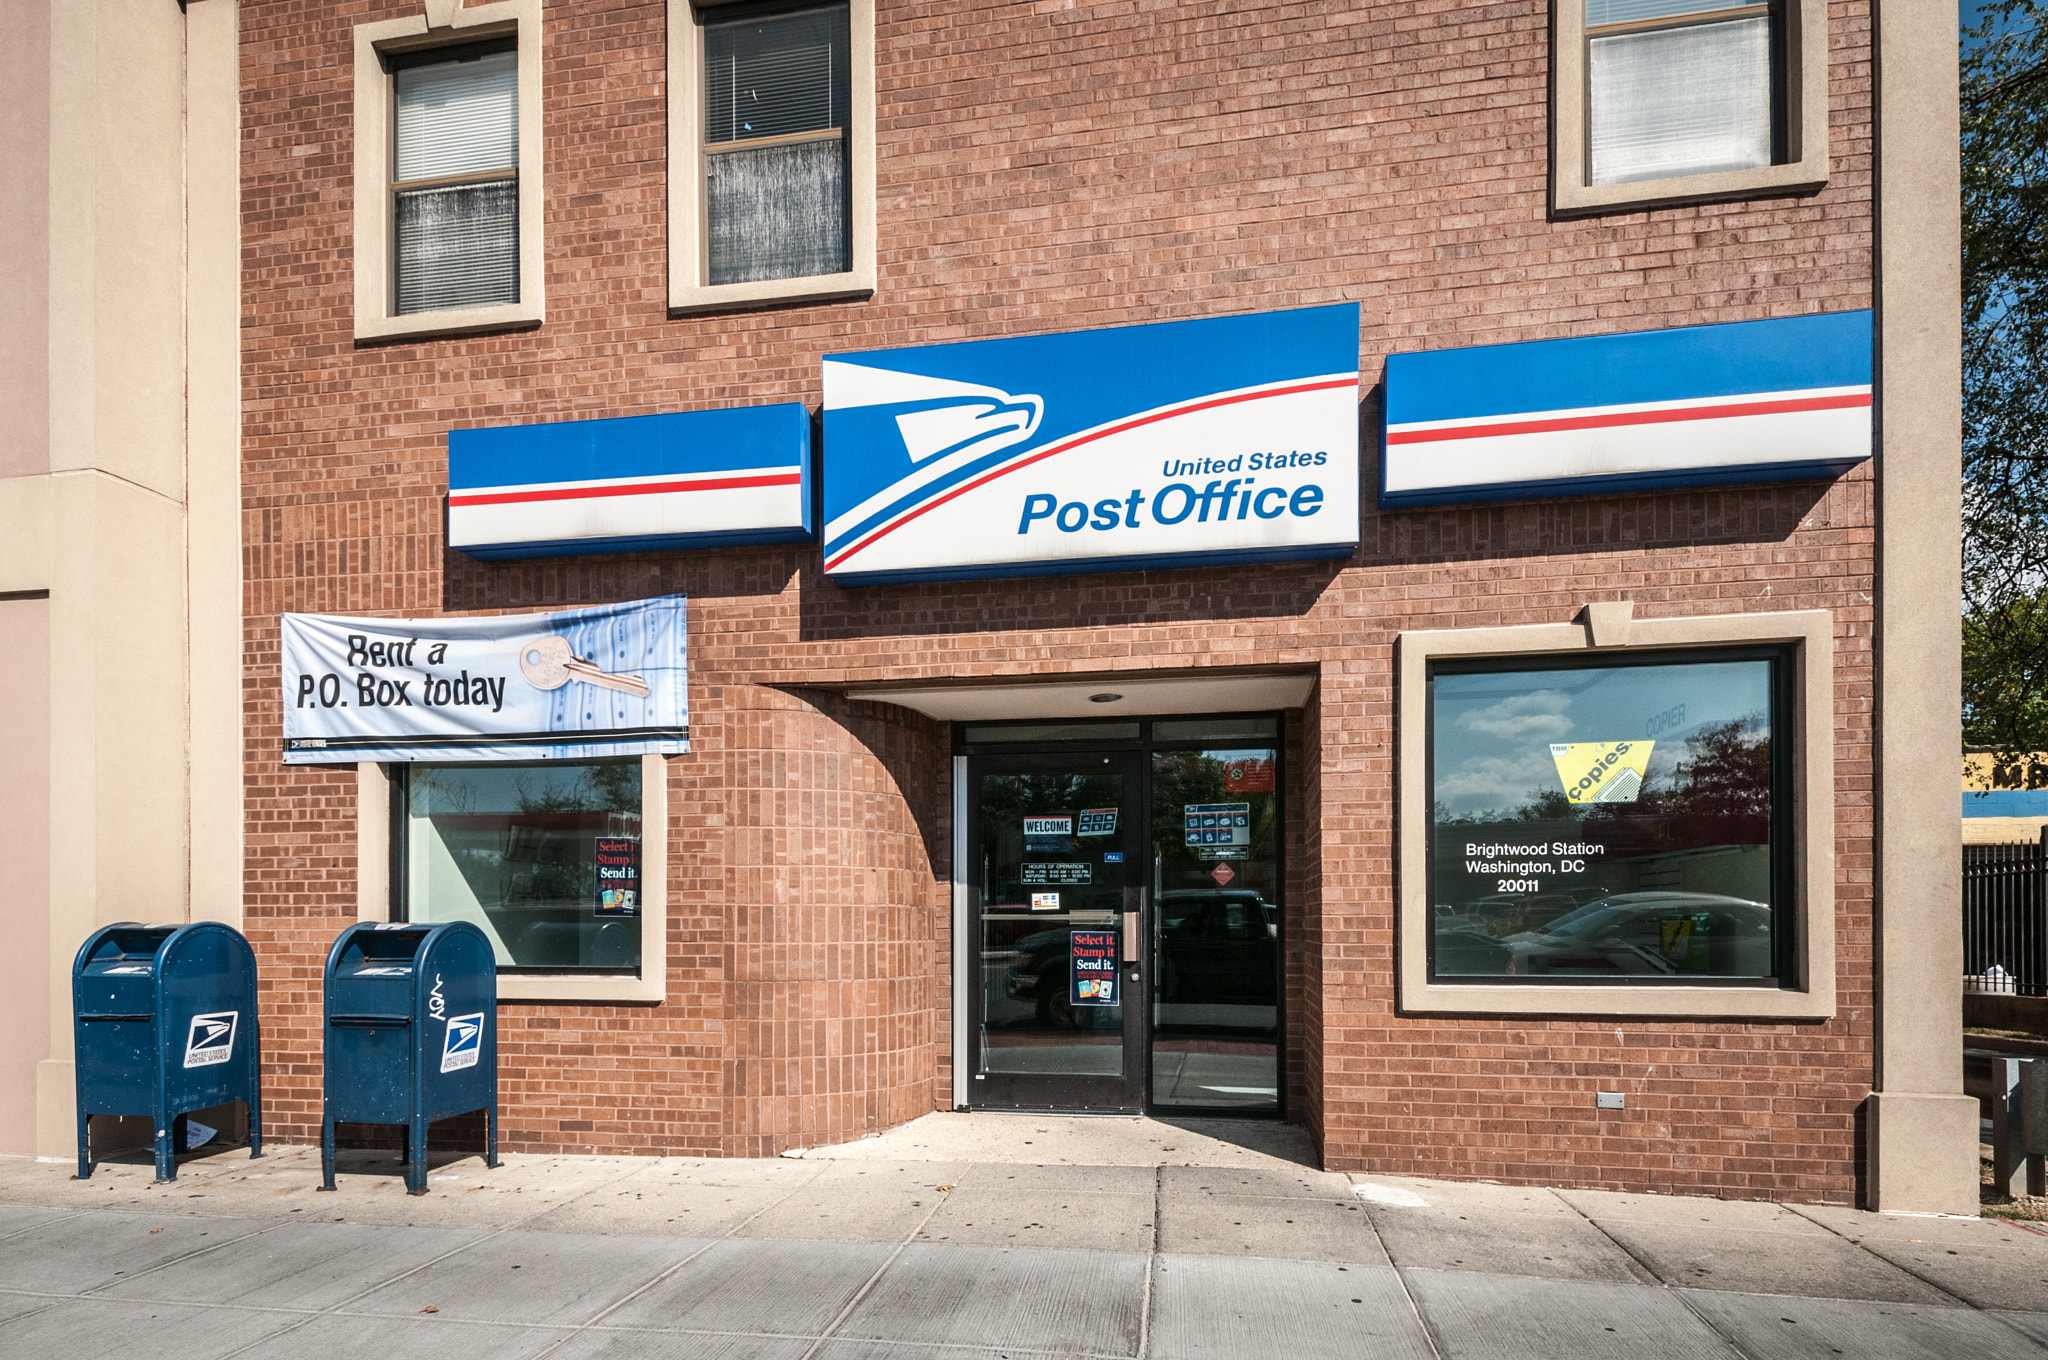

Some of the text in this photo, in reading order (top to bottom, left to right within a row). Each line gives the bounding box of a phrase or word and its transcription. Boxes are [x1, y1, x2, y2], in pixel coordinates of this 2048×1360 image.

[1162, 450, 1328, 478] United States
[1017, 477, 1324, 535] Post Office
[346, 634, 449, 668] Rent a
[296, 670, 507, 713] P.O. Box today
[1645, 702, 1687, 738] COPIER
[1025, 820, 1070, 833] WELCOME
[600, 841, 628, 852] Select
[1465, 841, 1605, 859] Brightwood Station
[597, 853, 630, 867] Stamp
[600, 866, 638, 879] Send it.
[1465, 860, 1586, 876] Washington, DC
[1497, 879, 1539, 892] 20011
[1074, 934, 1115, 945] Select it.
[1072, 946, 1105, 959] Stamp
[1076, 959, 1114, 970] Send it.
